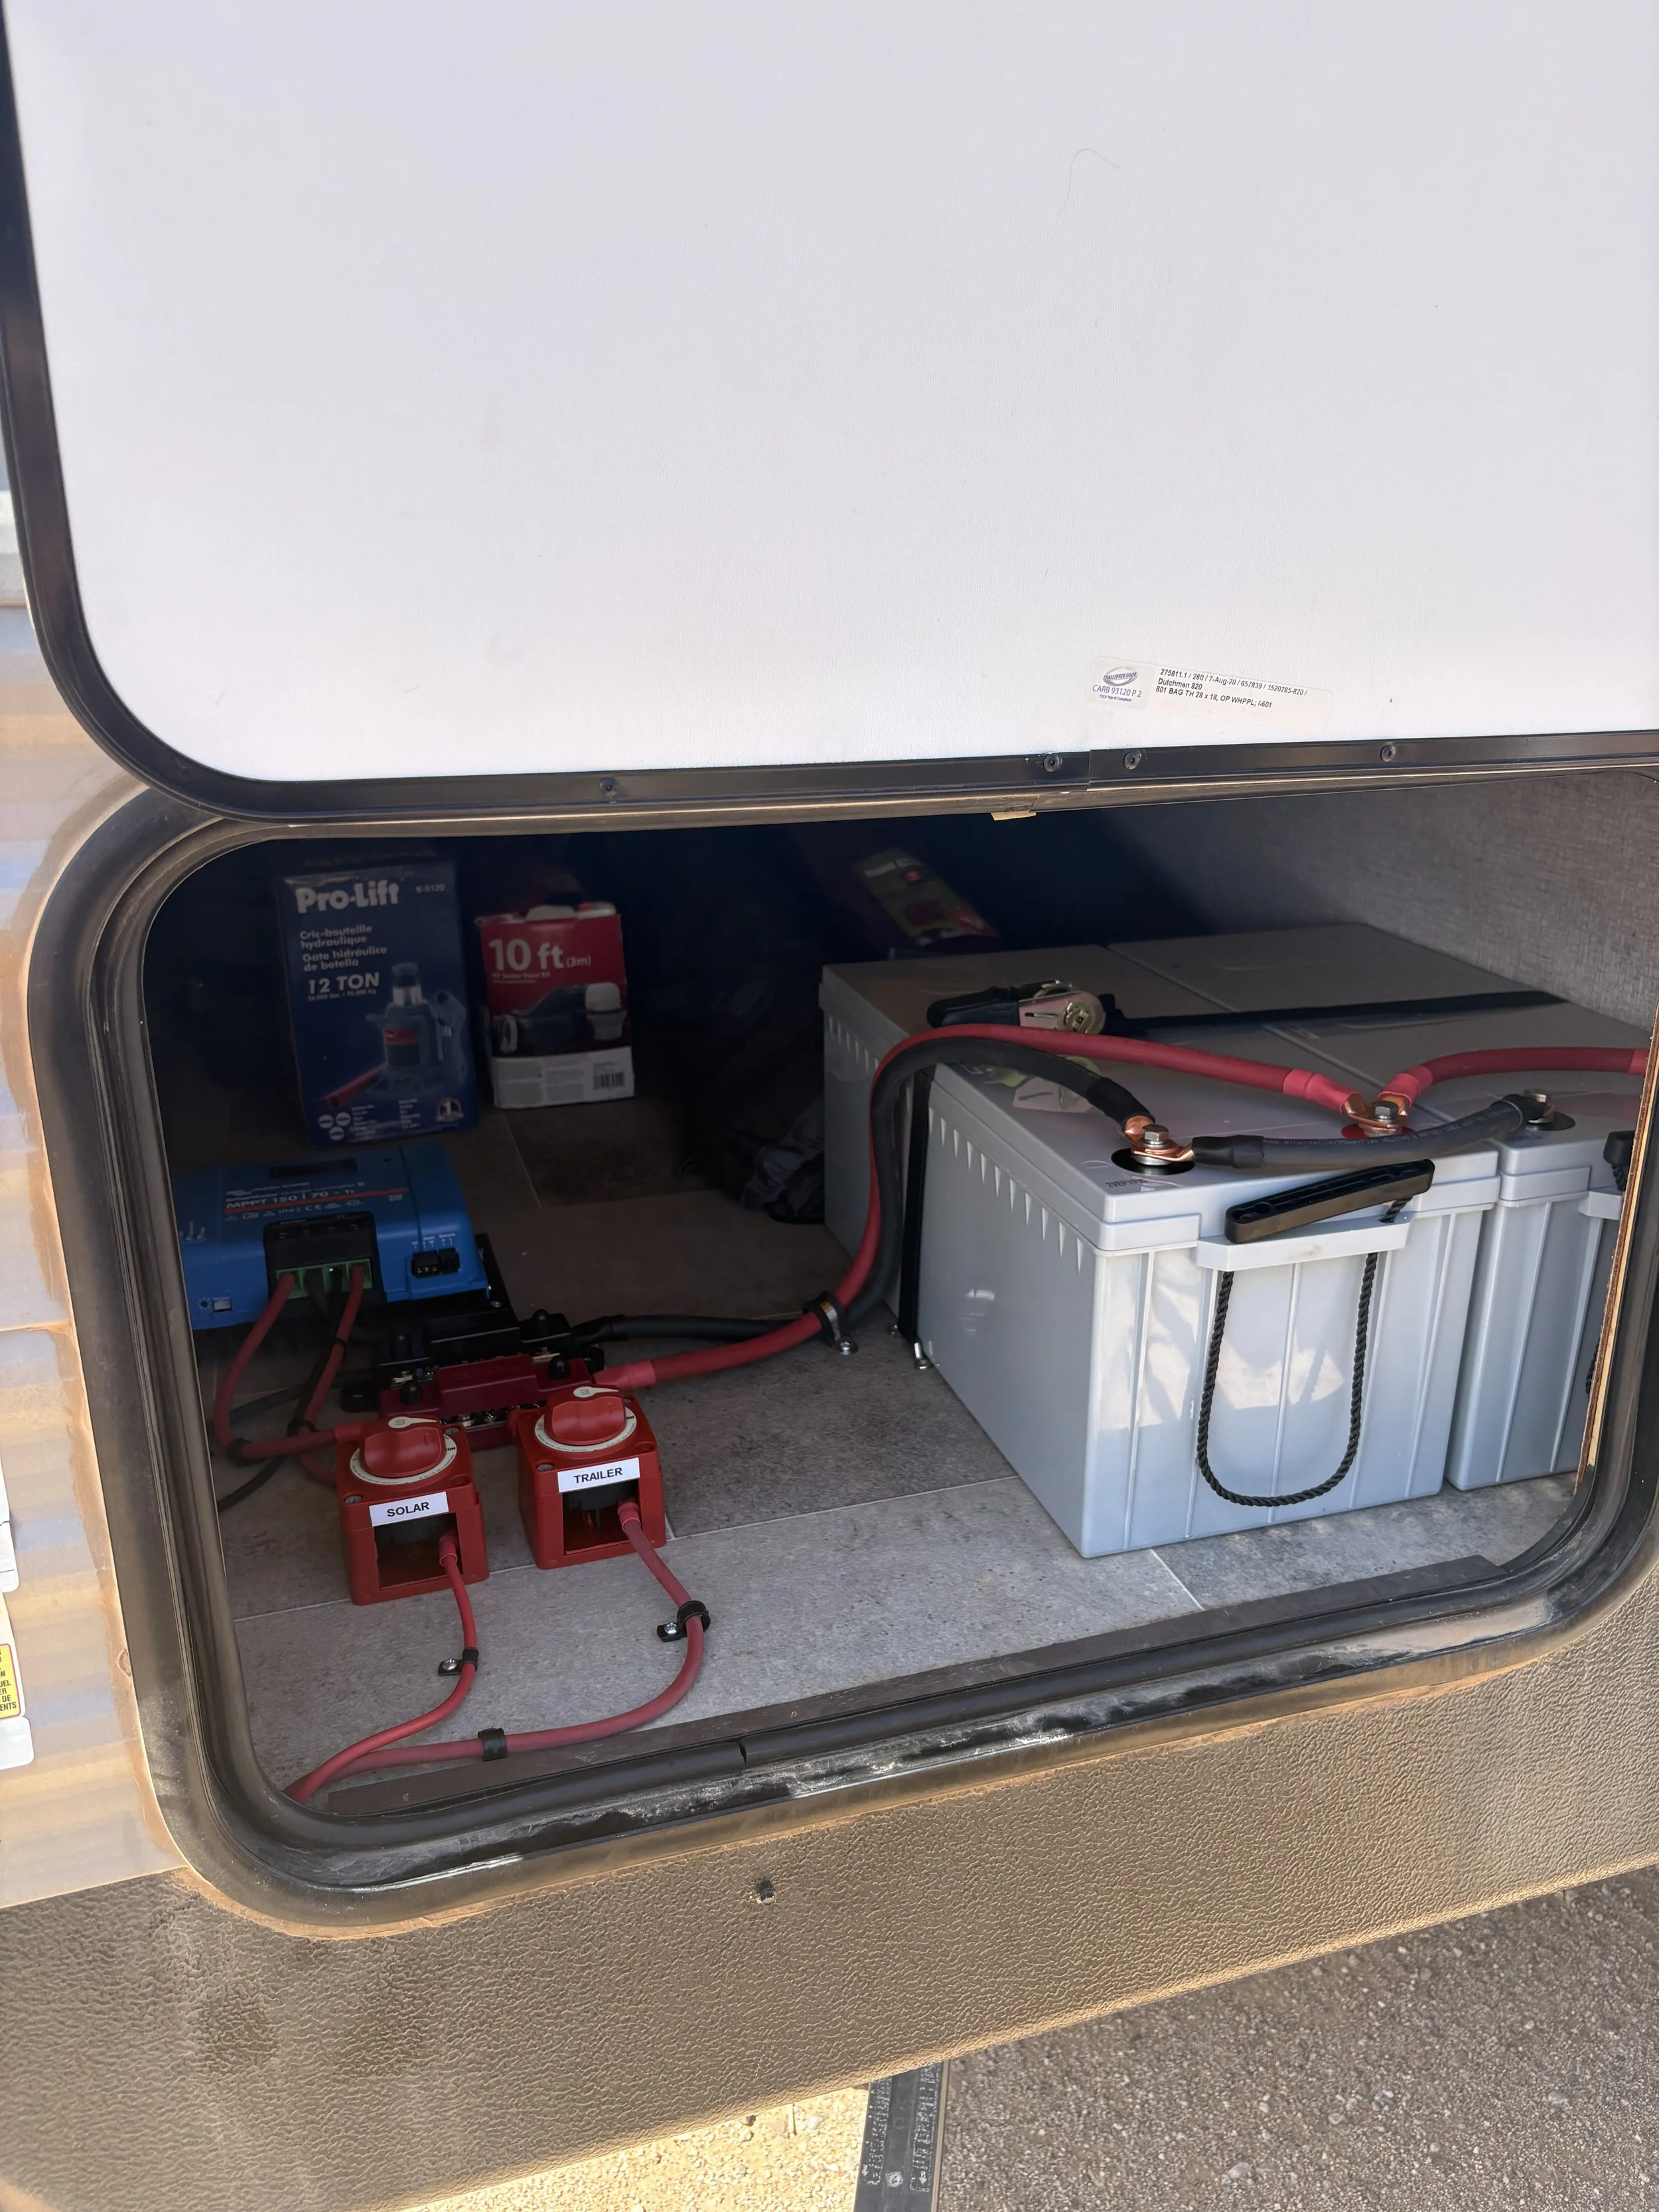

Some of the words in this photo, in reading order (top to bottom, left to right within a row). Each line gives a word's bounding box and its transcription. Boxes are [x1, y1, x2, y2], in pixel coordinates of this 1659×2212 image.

[1092, 684, 1110, 694] CARB
[1111, 687, 1131, 696] 93120
[1209, 676, 1236, 686] 7-Aug-20
[1241, 681, 1262, 690] 657839
[295, 879, 399, 914] Pro-Lift
[300, 924, 373, 940] Cric-bouteille
[301, 935, 367, 950] hydraulique
[303, 952, 330, 963] Gato
[332, 946, 388, 960] hidráulico
[488, 938, 532, 971] 10
[538, 941, 565, 970] ft
[566, 956, 592, 968] (3m)
[304, 962, 319, 972] de
[321, 958, 359, 970] botella
[308, 978, 331, 994] 12
[336, 972, 380, 992] TON
[226, 1198, 268, 1209] MPPT
[272, 1195, 298, 1203] 150
[573, 1467, 622, 1483] TRAILER
[387, 1501, 429, 1517] SOLAR
